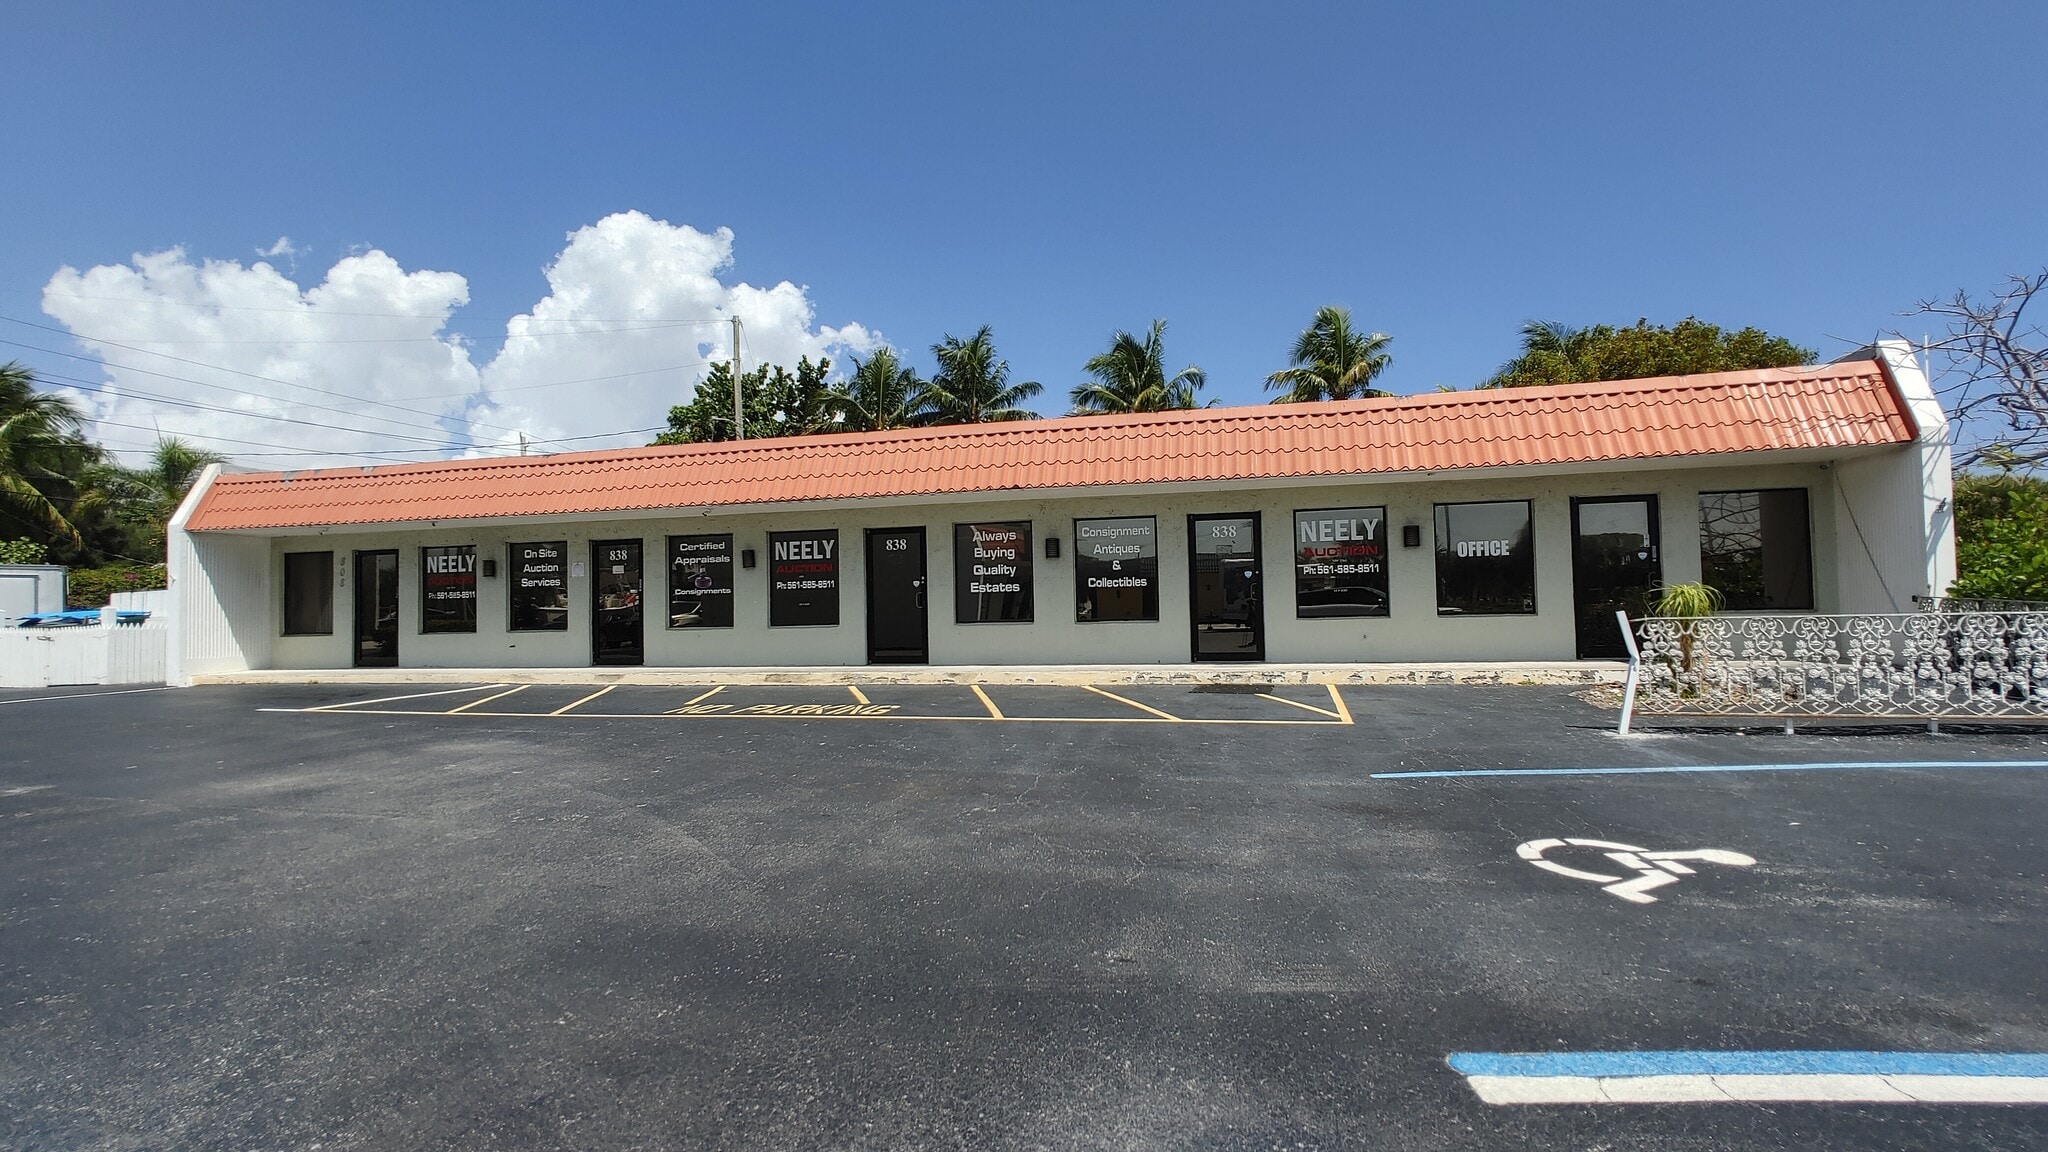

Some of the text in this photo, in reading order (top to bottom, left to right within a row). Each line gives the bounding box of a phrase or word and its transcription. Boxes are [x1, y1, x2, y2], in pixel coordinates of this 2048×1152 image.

[1081, 525, 1150, 539] Consignment
[1212, 525, 1237, 538] 838
[1300, 518, 1379, 543] NEELY
[972, 531, 1017, 544] Always
[679, 541, 726, 552] Certified
[774, 540, 836, 561] NEELY
[885, 538, 907, 551] 838
[1093, 543, 1141, 556] Antiques
[1457, 539, 1510, 559] OFFICE
[524, 548, 558, 559] On Site
[609, 550, 628, 561] 838
[974, 547, 1016, 560] Buying
[1303, 545, 1378, 558] AUCTION
[426, 554, 476, 574] NEELY
[674, 554, 731, 566] Appraisals
[1111, 559, 1122, 571] &
[523, 563, 559, 573] Auction
[775, 562, 833, 574] AUCTION
[973, 564, 1017, 578] Quality
[1303, 563, 1380, 575] Ph: 561-585-8511
[521, 577, 561, 588] Services
[787, 579, 836, 590] 561-585-8511
[970, 582, 1020, 594] Estates
[1088, 576, 1148, 589] Collectibles
[674, 587, 732, 597] Consignments
[729, 704, 901, 715] PARKING
